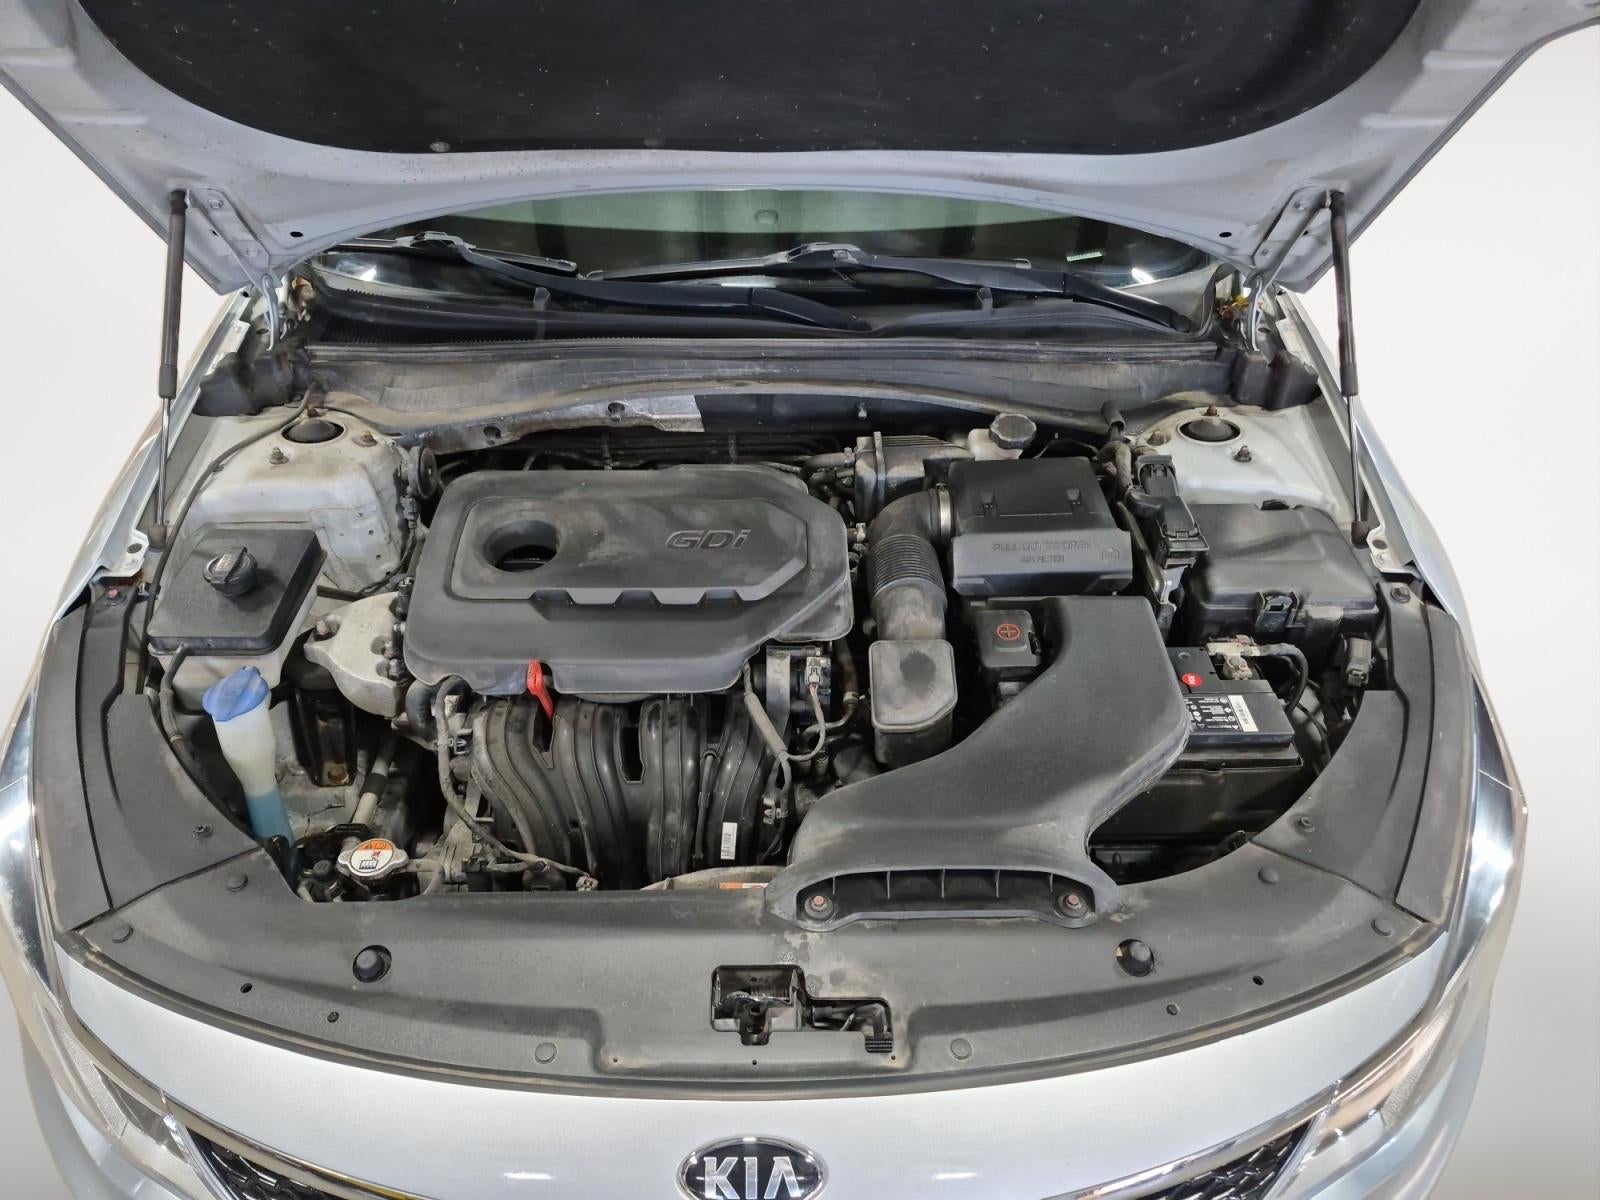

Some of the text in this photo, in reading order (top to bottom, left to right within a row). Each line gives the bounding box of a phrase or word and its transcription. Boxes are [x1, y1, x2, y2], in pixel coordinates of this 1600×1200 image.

[992, 543, 1020, 552] PULL
[1046, 541, 1060, 550] TO
[703, 1156, 802, 1199] KIA
